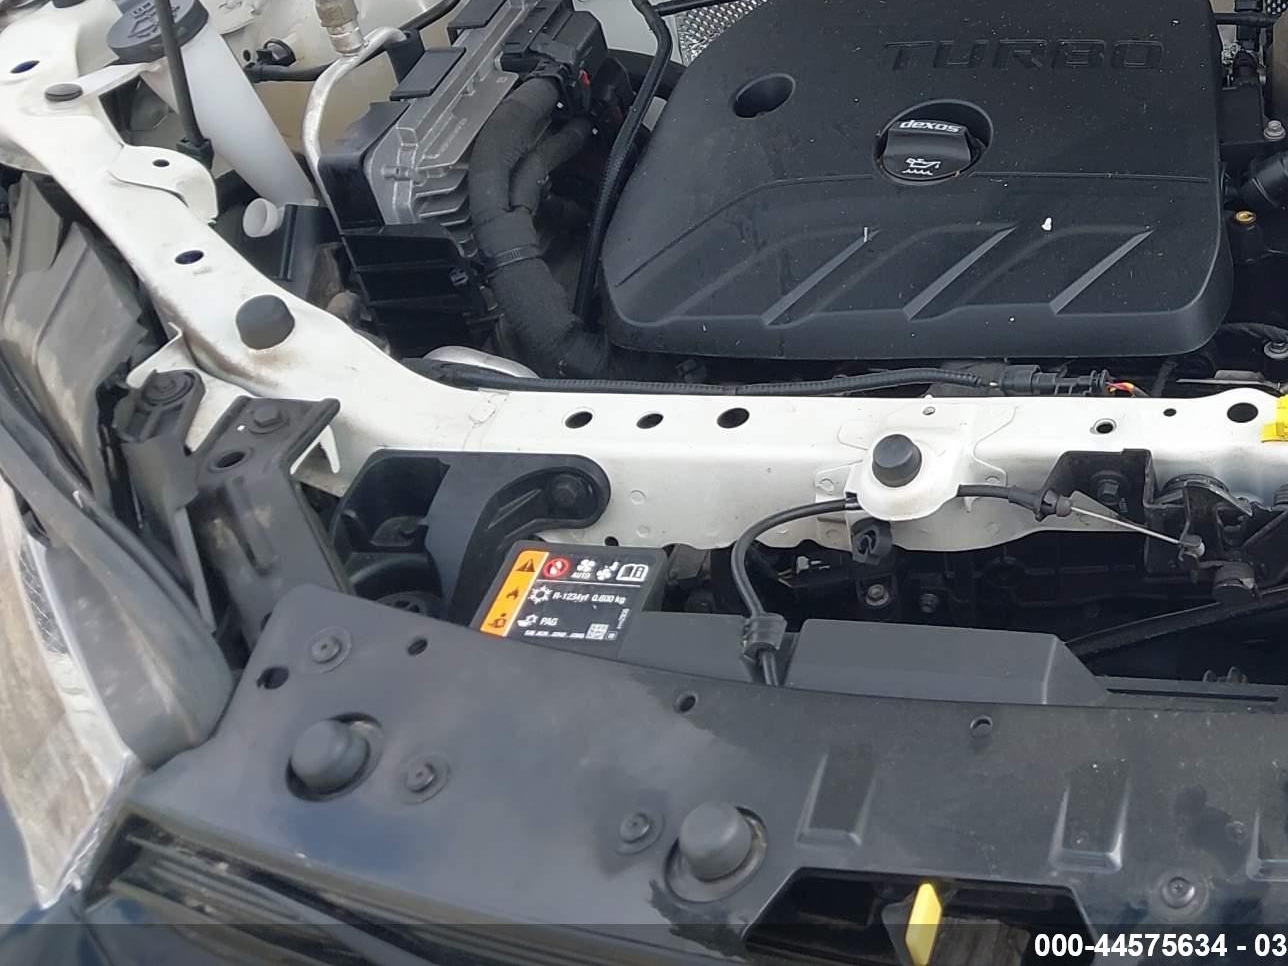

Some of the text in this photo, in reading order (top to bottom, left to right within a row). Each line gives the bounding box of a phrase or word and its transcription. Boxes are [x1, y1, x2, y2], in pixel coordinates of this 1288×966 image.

[884, 38, 1165, 72] TURBO
[899, 119, 962, 134] dexos
[614, 594, 626, 605] kg
[539, 617, 559, 626] PAG
